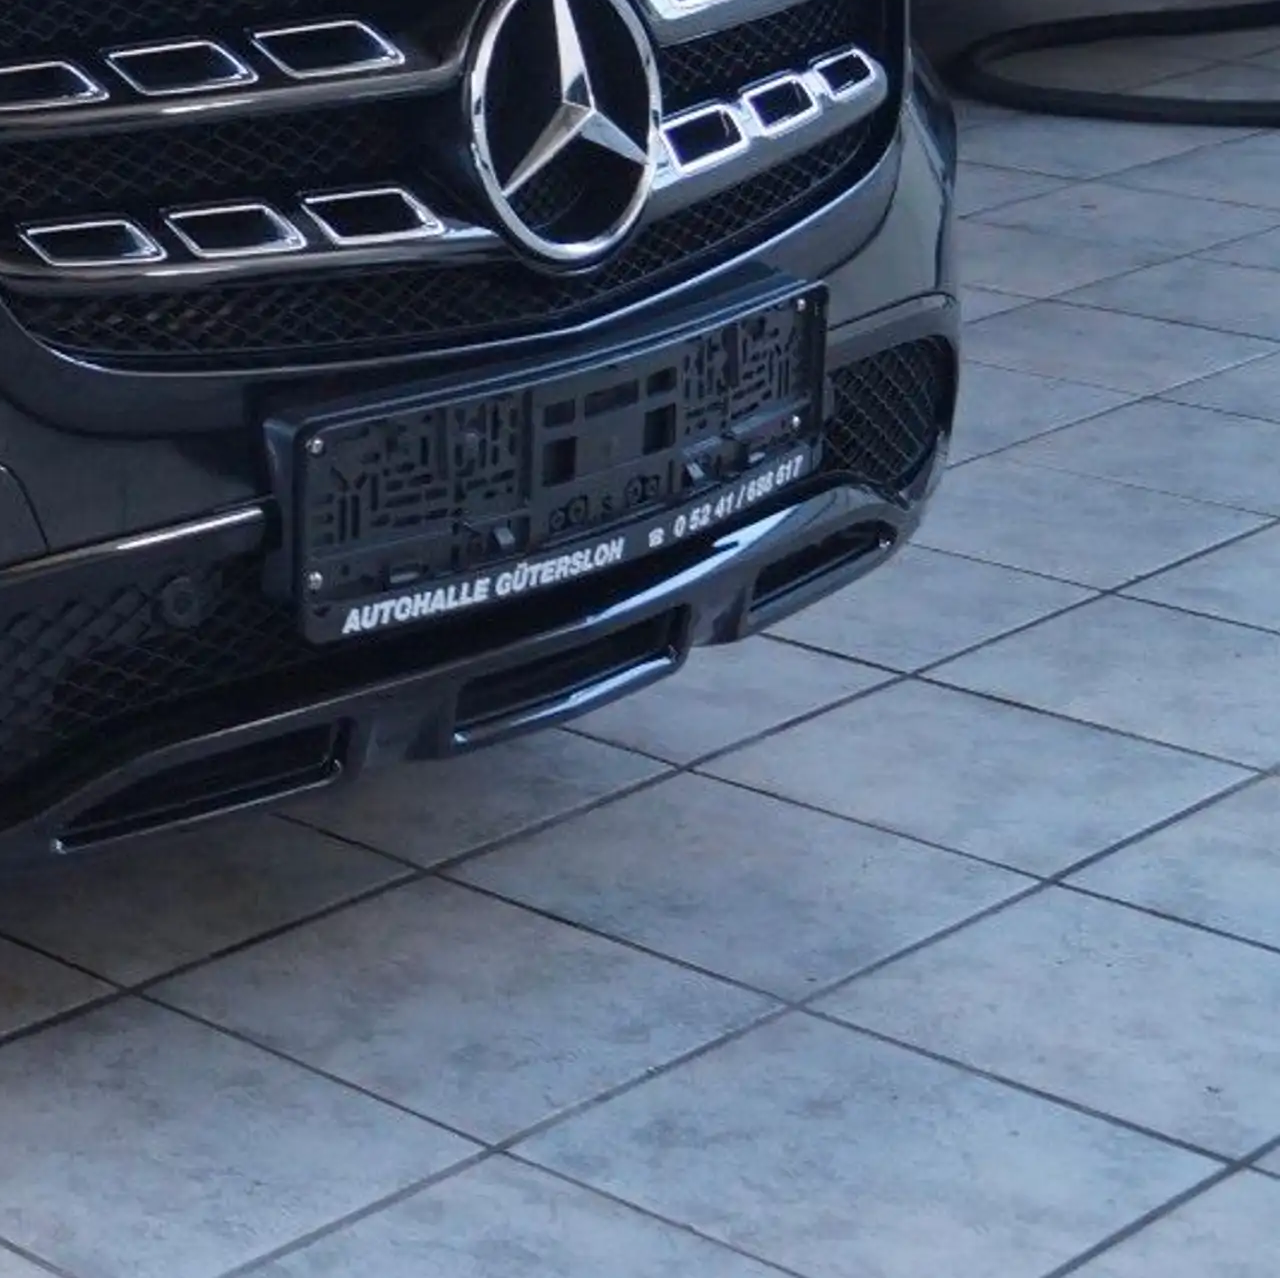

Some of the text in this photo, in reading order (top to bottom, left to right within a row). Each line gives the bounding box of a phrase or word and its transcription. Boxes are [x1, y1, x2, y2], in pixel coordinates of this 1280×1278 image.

[342, 578, 491, 634] AUTOHALLE
[495, 537, 625, 596] GÜTERSLOH
[673, 515, 687, 538] 0
[689, 503, 713, 531] 52
[714, 492, 735, 518] 41
